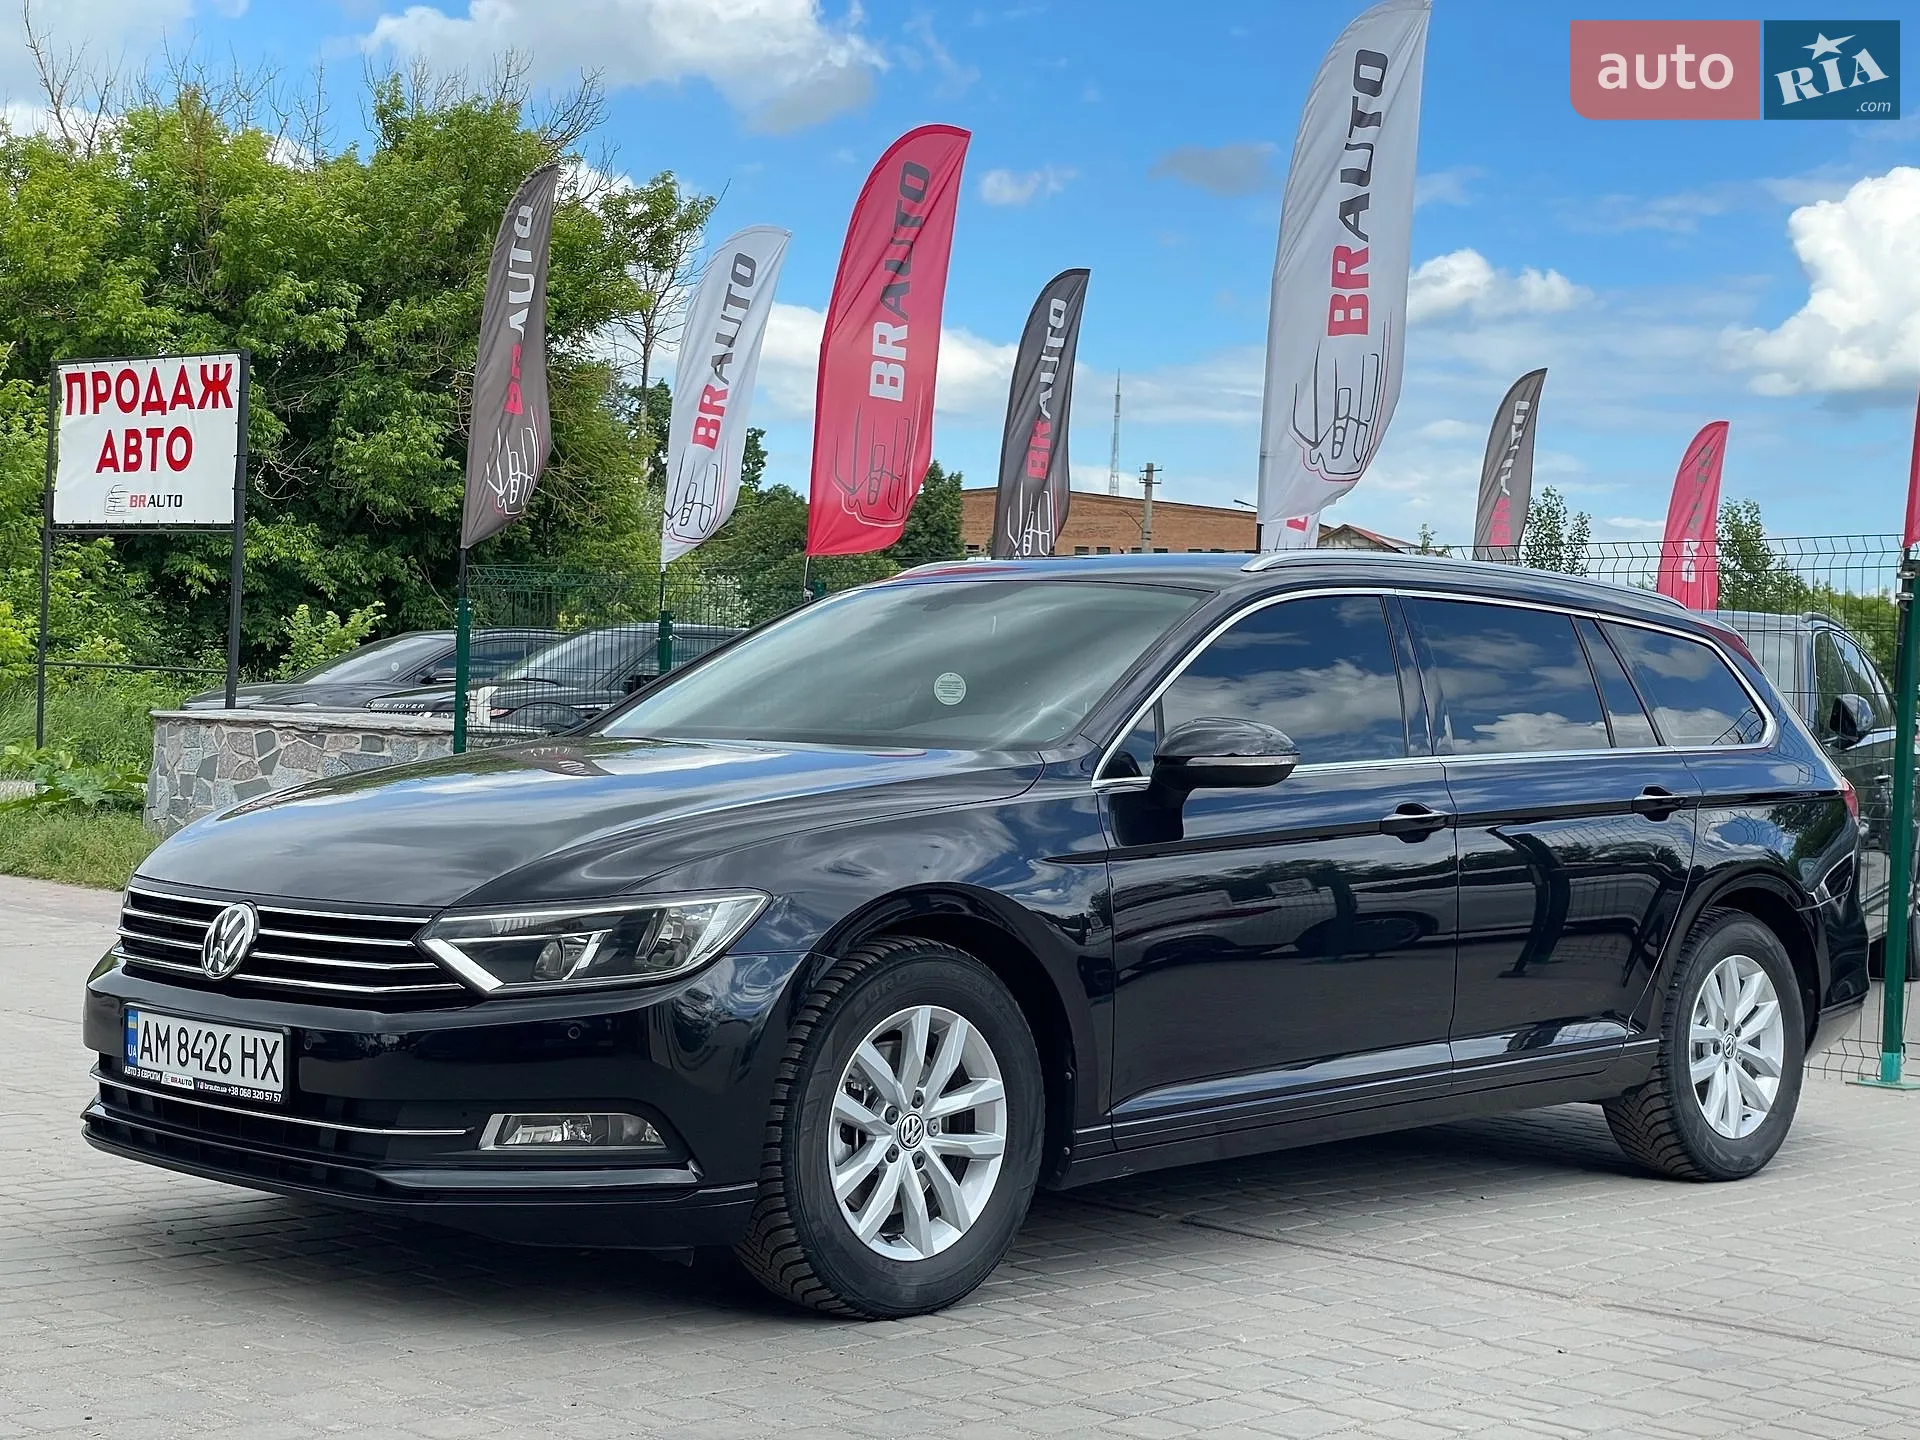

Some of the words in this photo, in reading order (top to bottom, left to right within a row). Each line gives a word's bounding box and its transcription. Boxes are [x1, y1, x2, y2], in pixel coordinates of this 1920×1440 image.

[1327, 49, 1389, 336] BRAUTO
[869, 160, 930, 402] BRAUTO
[691, 252, 759, 451] BRAUTO
[65, 363, 234, 417] ПРОДАЖ
[1026, 298, 1067, 480] BRAUTO
[95, 425, 194, 474] АВТО
[128, 494, 183, 508] BRAUTO
[127, 1044, 137, 1058] UA
[140, 1020, 171, 1065] AM
[176, 1026, 233, 1075] 8426
[240, 1035, 281, 1083] HX
